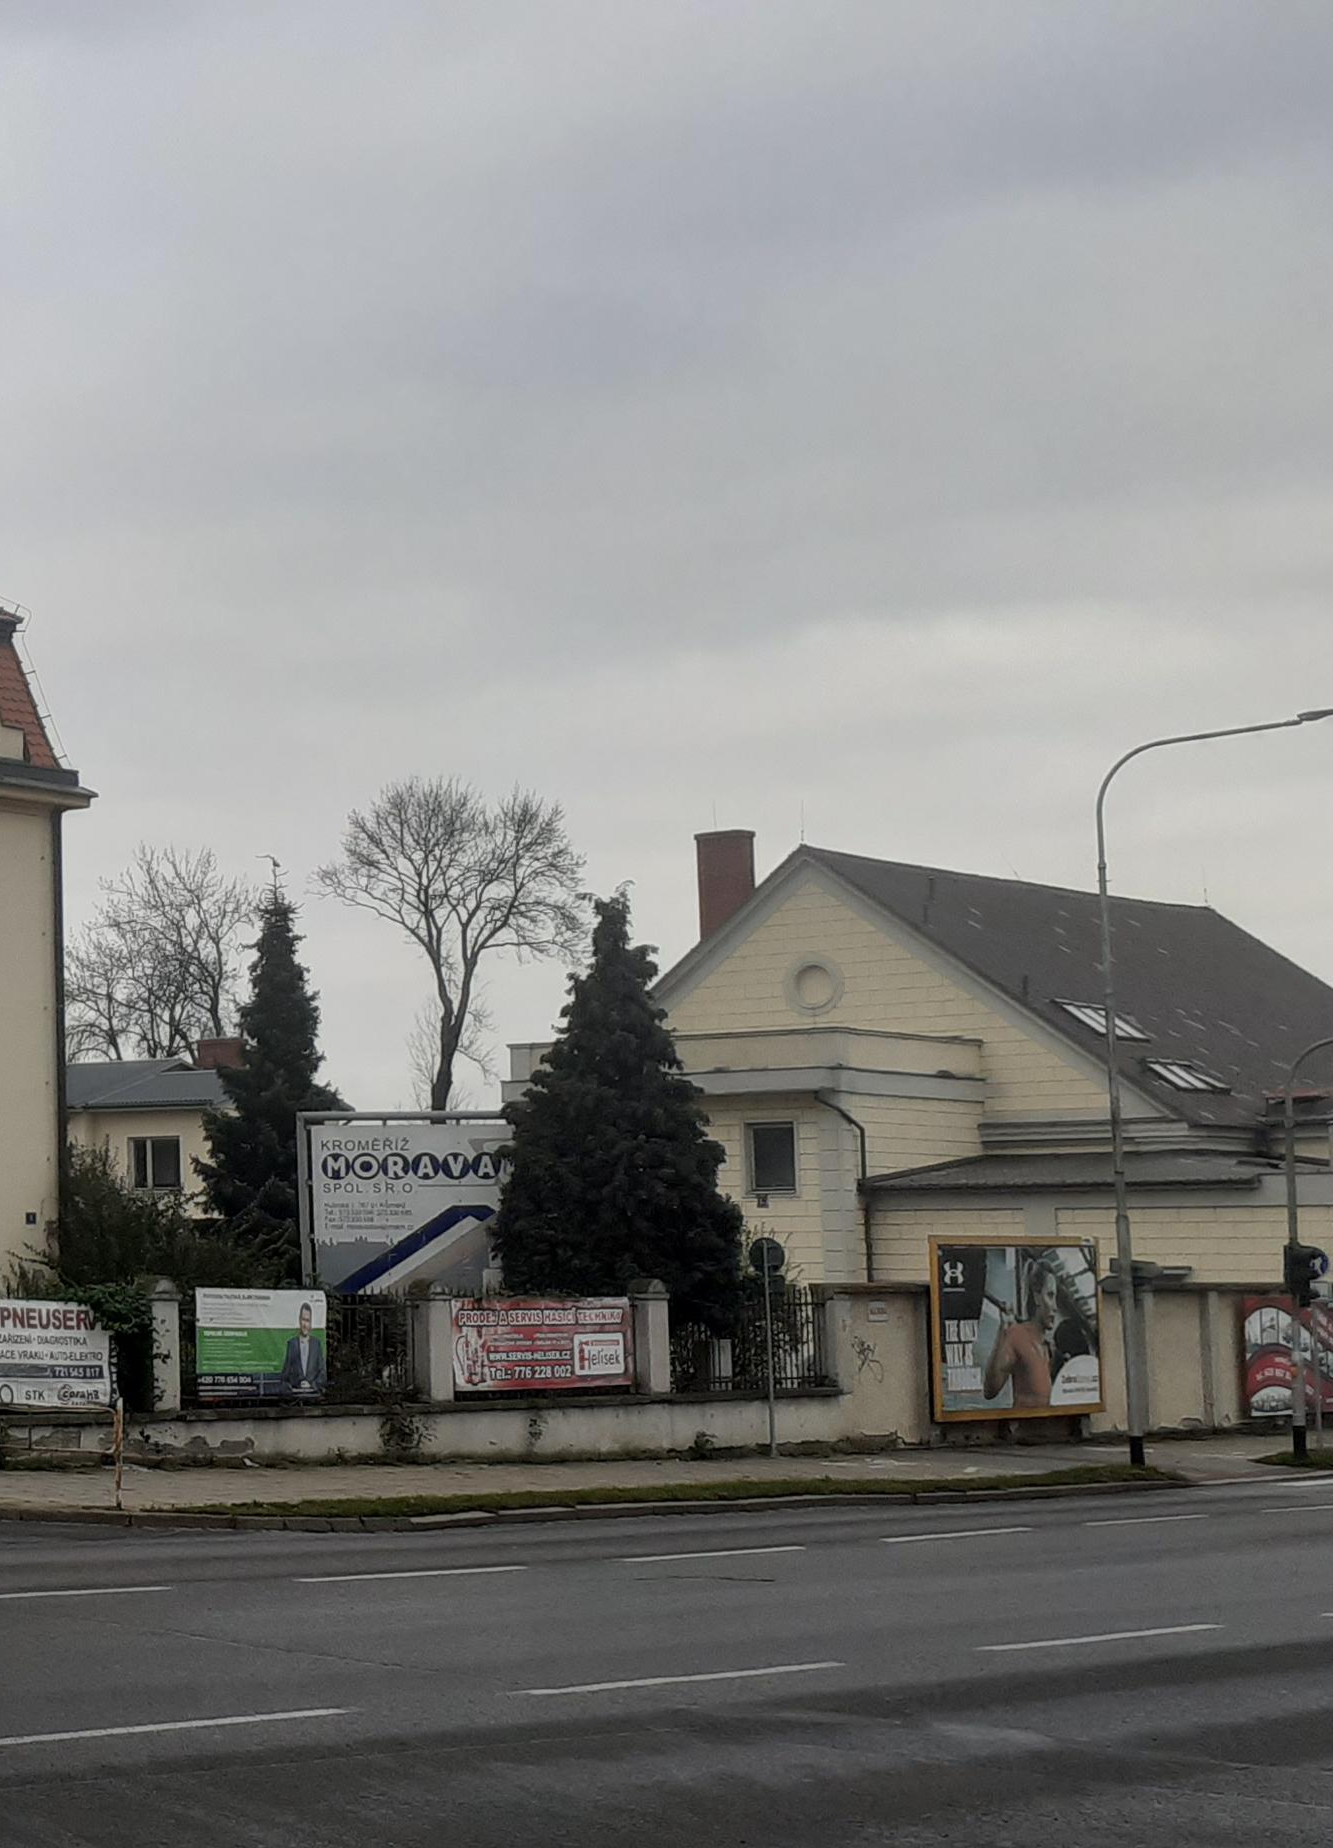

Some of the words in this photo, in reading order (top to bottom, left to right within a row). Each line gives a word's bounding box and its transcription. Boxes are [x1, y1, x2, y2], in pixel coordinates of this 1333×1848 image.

[320, 1138, 410, 1151] KROMĚŘÍŽ
[323, 1153, 499, 1180] MORAVA
[458, 1310, 497, 1325] PRODEJ
[499, 1311, 507, 1324] A
[508, 1310, 542, 1324] SERVIS
[37, 1335, 88, 1346] DIAGNOSTIKA
[489, 1367, 511, 1380] Tel.:
[513, 1366, 532, 1379] 776
[533, 1365, 552, 1378] 228
[554, 1365, 572, 1377] 002
[24, 1389, 45, 1401] STK
